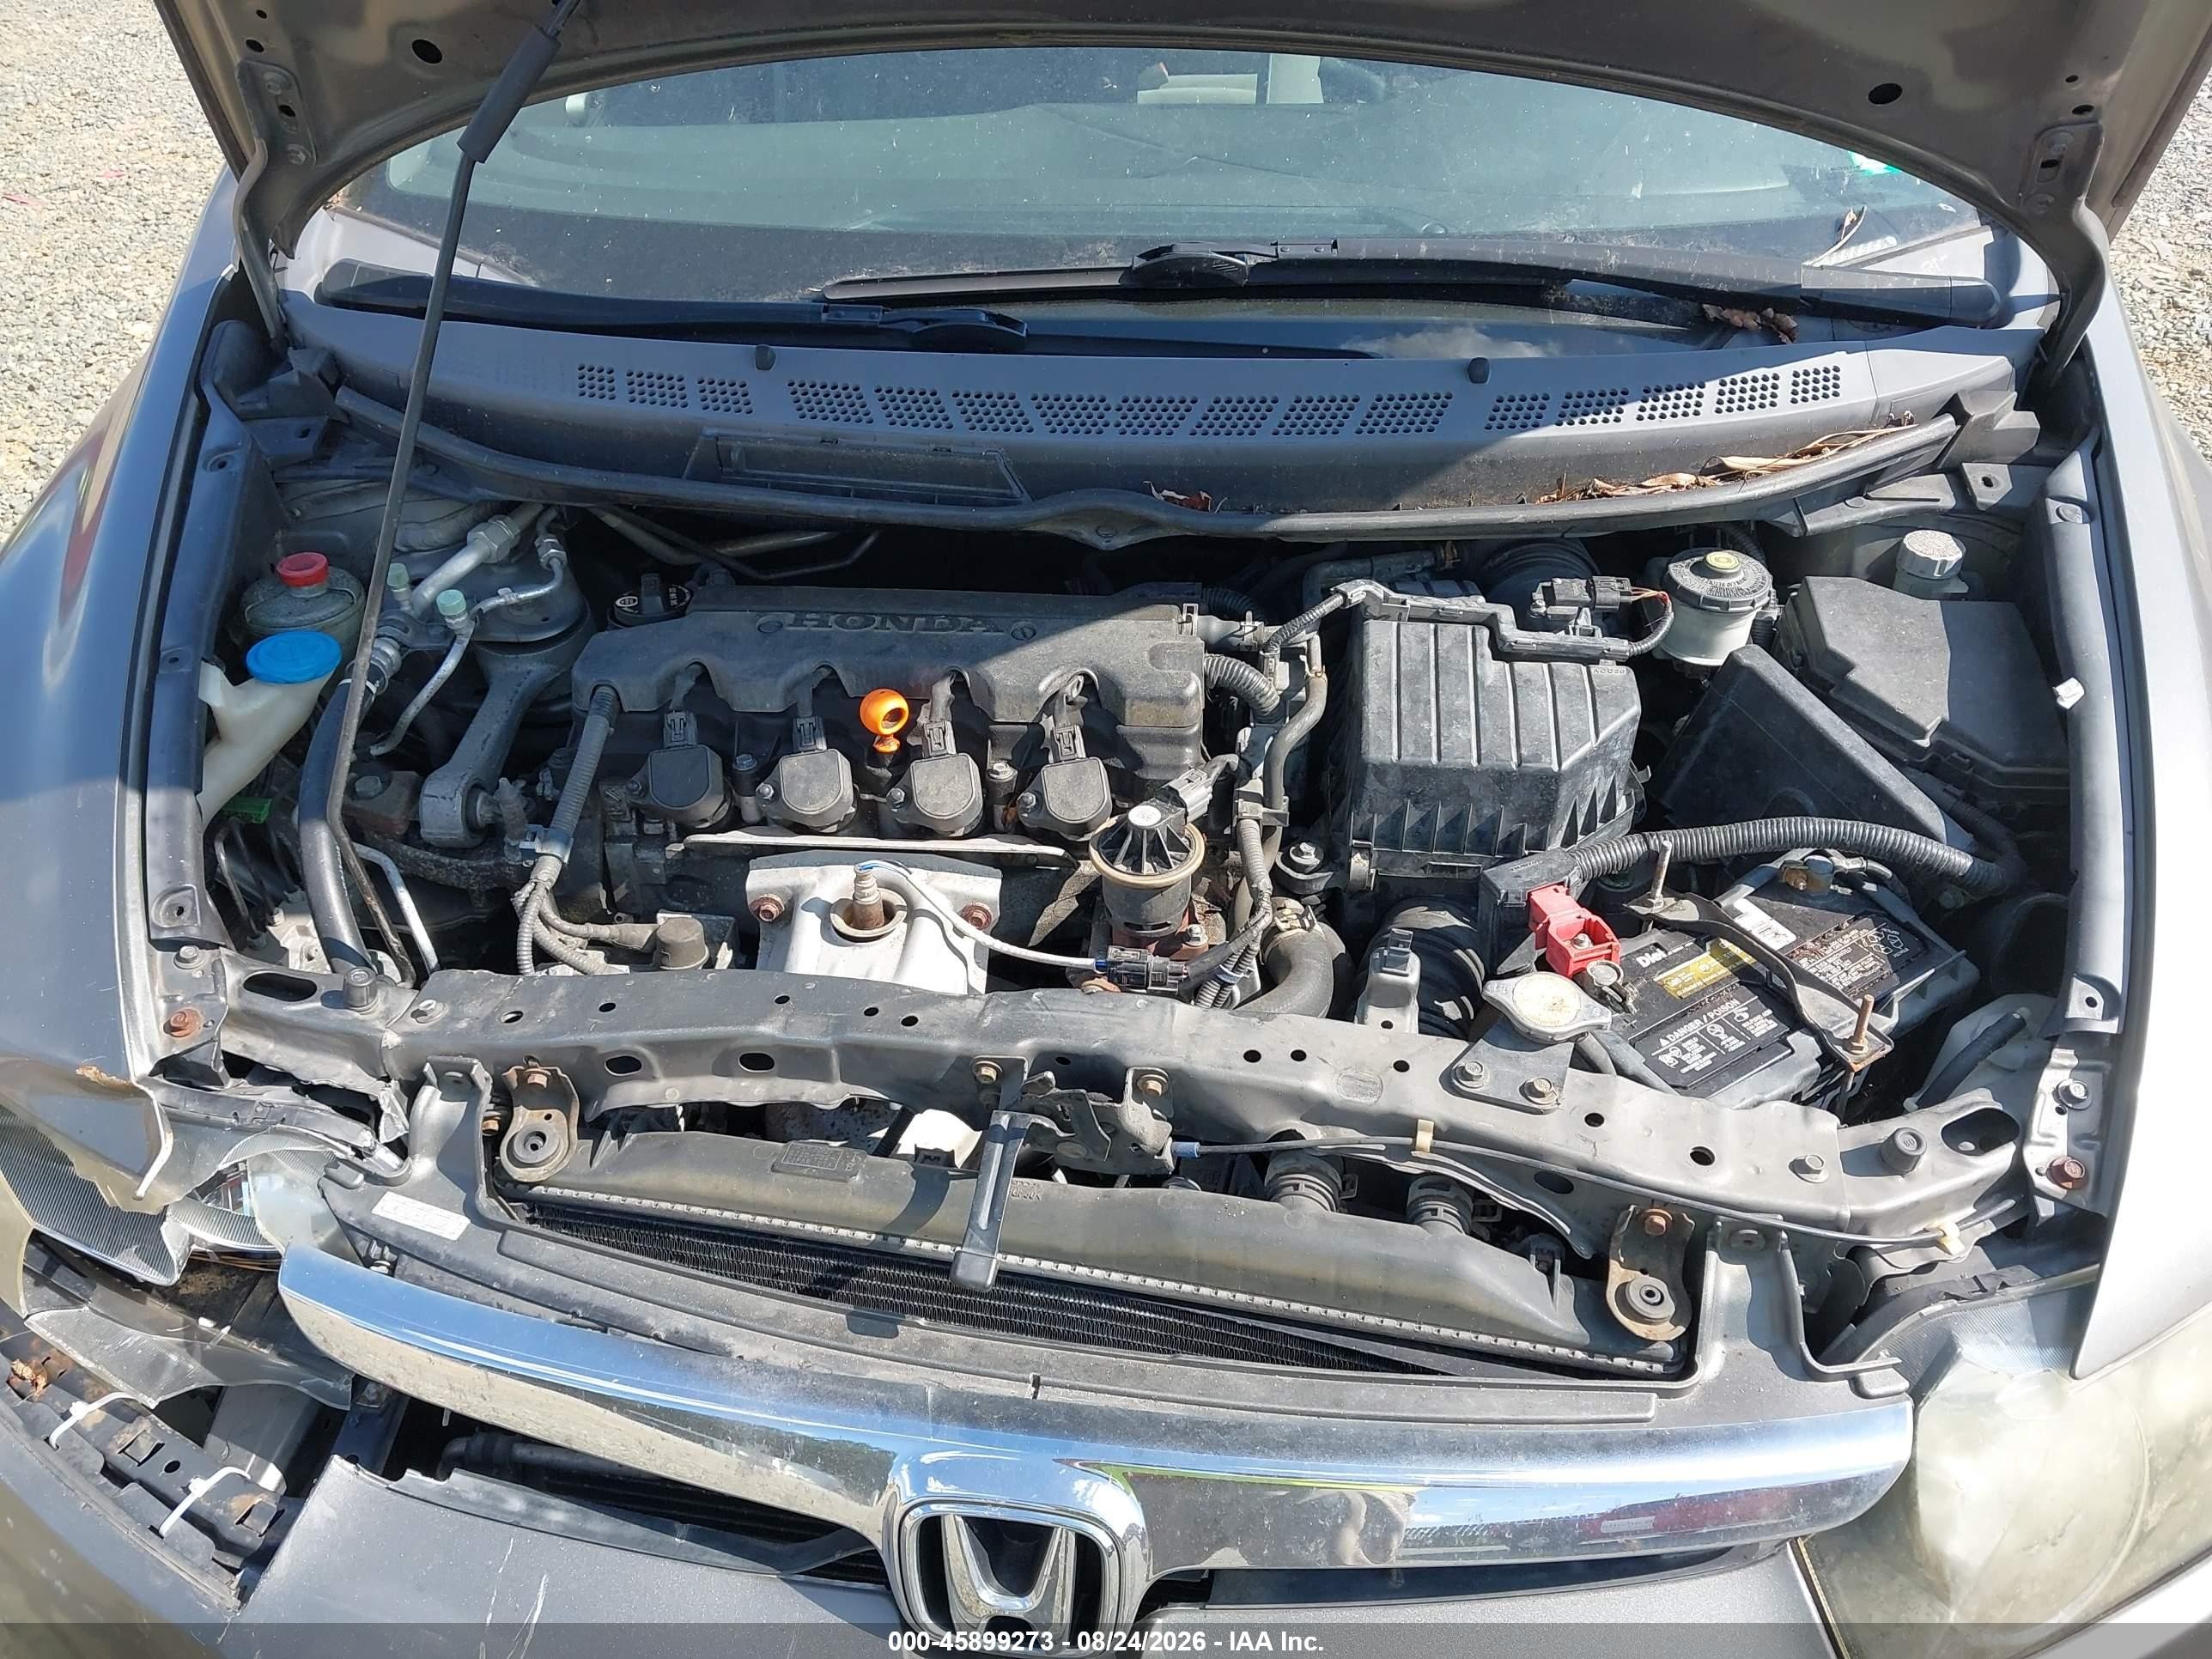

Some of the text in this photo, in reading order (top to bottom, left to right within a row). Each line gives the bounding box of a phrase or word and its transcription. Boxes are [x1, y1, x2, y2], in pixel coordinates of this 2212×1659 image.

[787, 612, 1005, 635] HONDA
[1666, 1018, 1705, 1042] DANGER
[1708, 999, 1741, 1020] POISON
